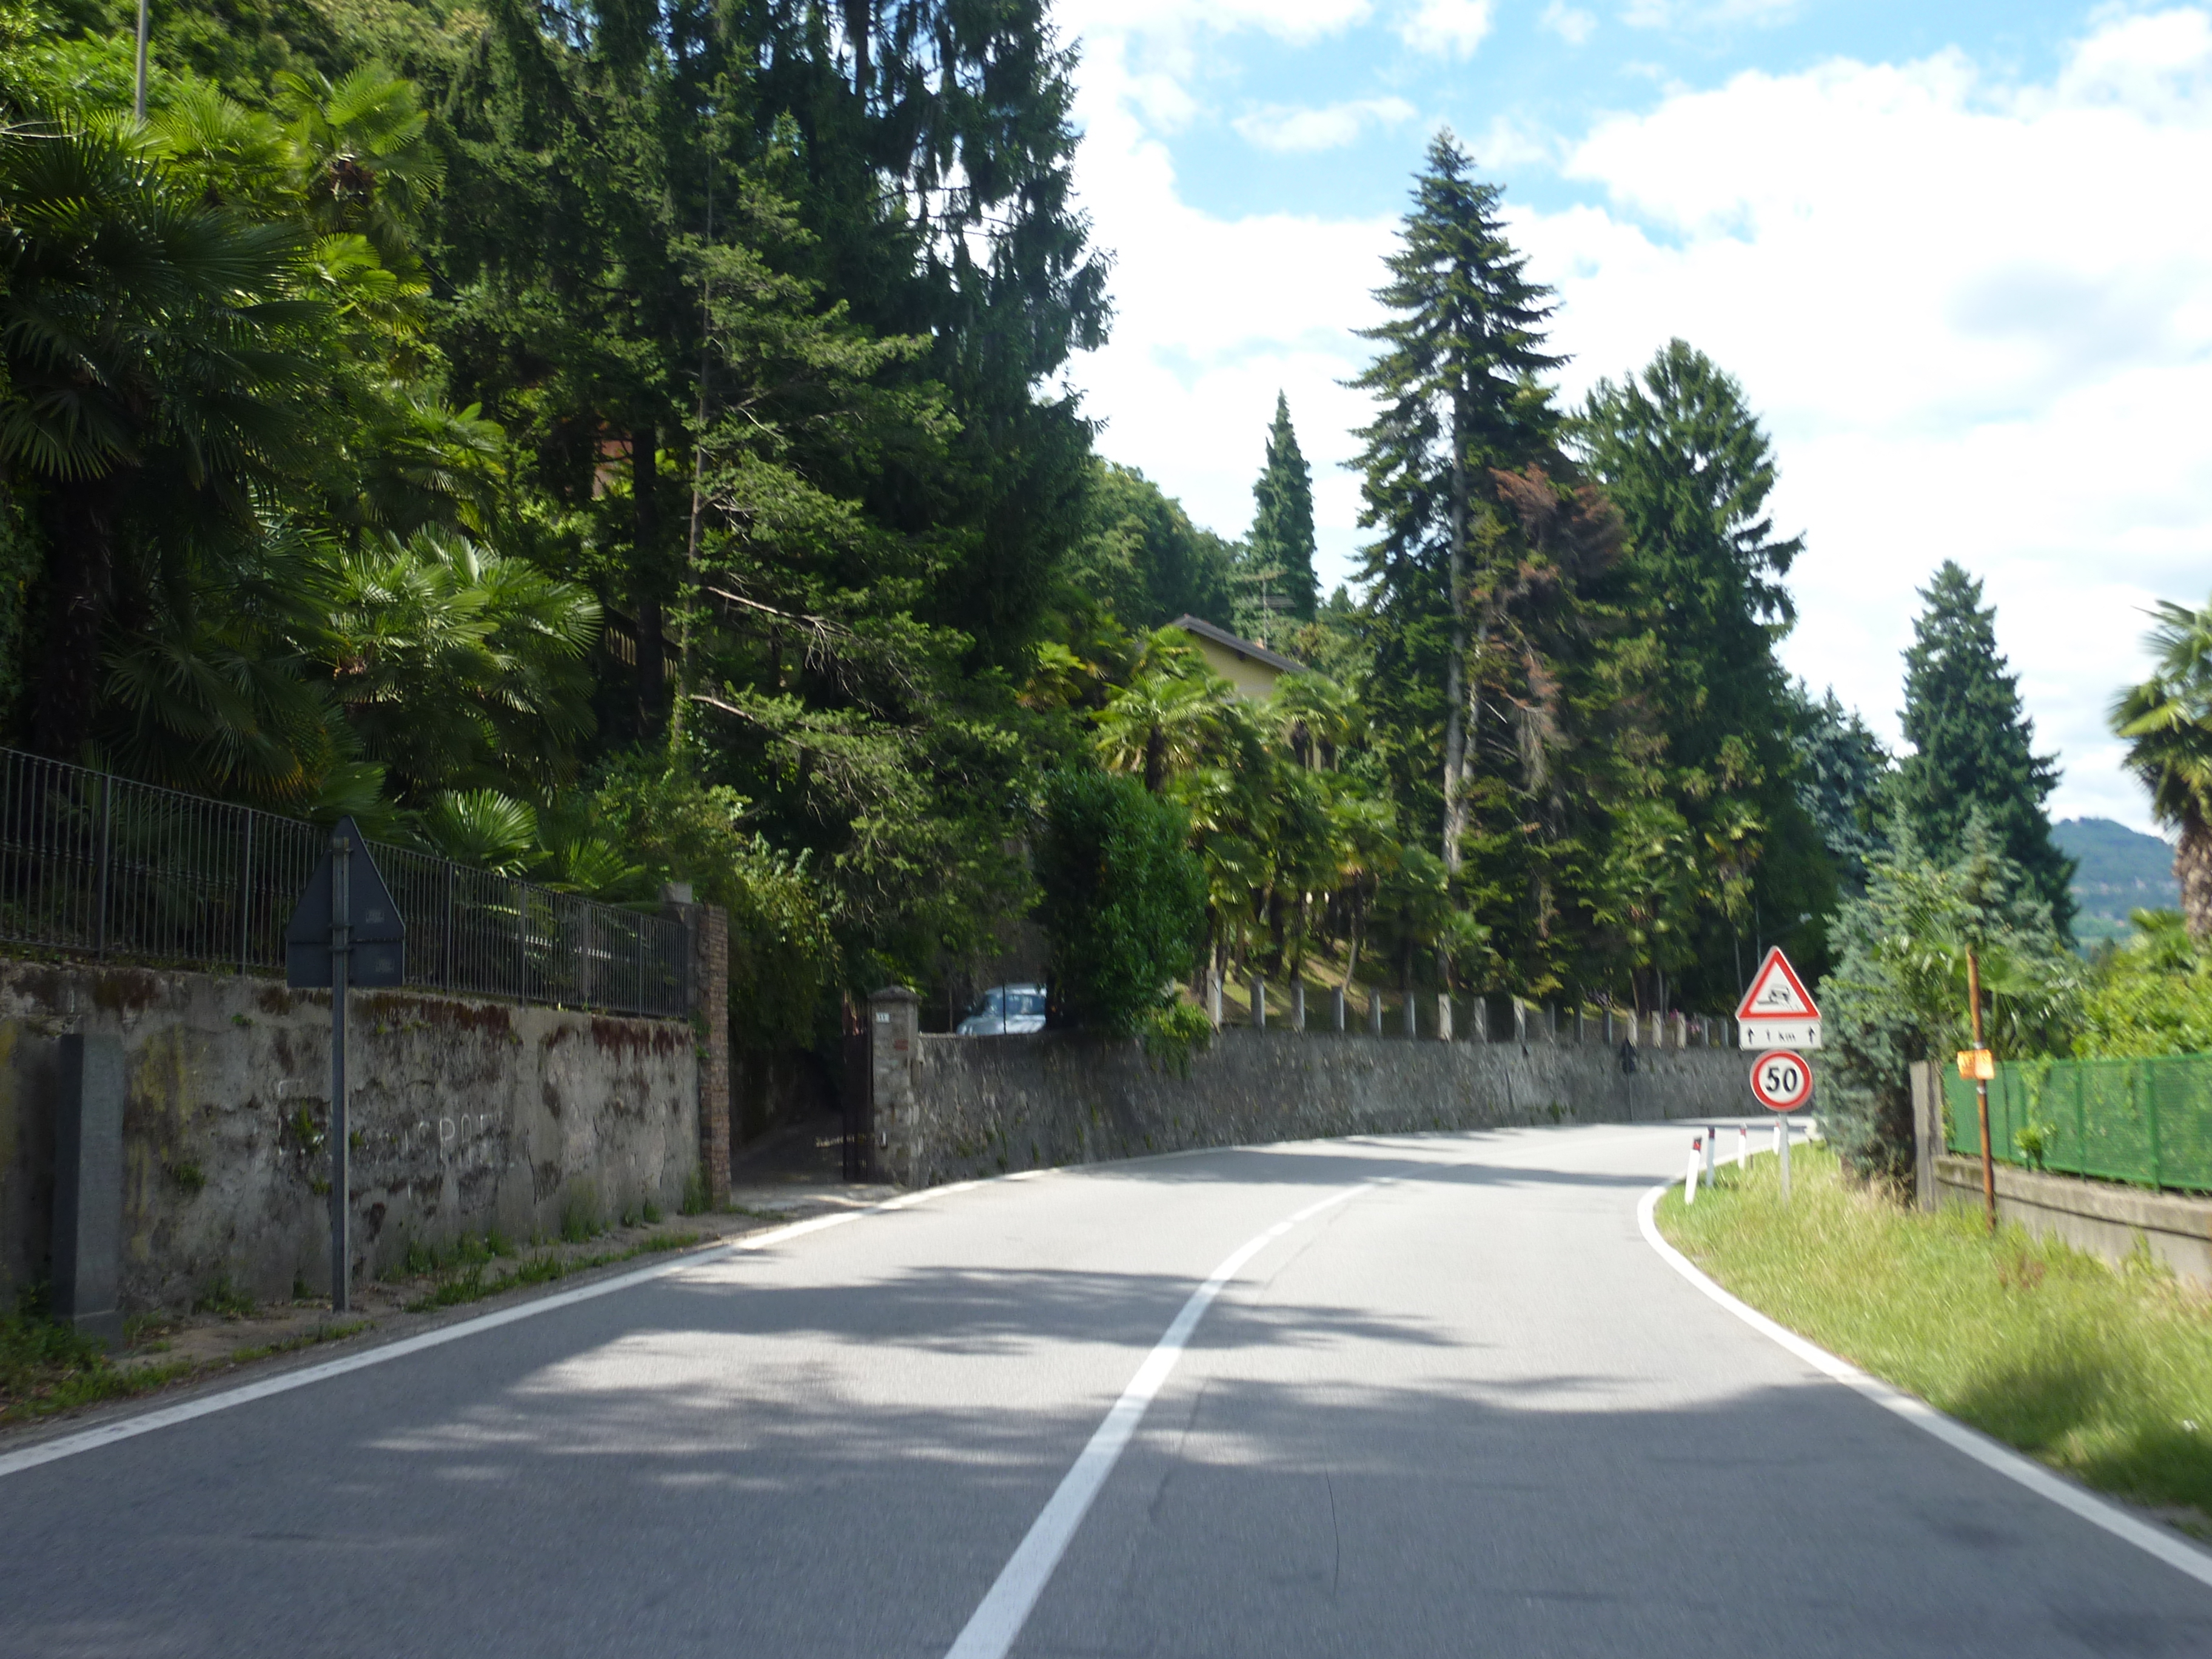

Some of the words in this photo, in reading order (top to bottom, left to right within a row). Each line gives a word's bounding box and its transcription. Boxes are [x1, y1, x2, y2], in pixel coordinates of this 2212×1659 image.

[1765, 1028, 1771, 1042] 1
[1777, 1030, 1796, 1042] km
[1765, 1066, 1798, 1092] 50
